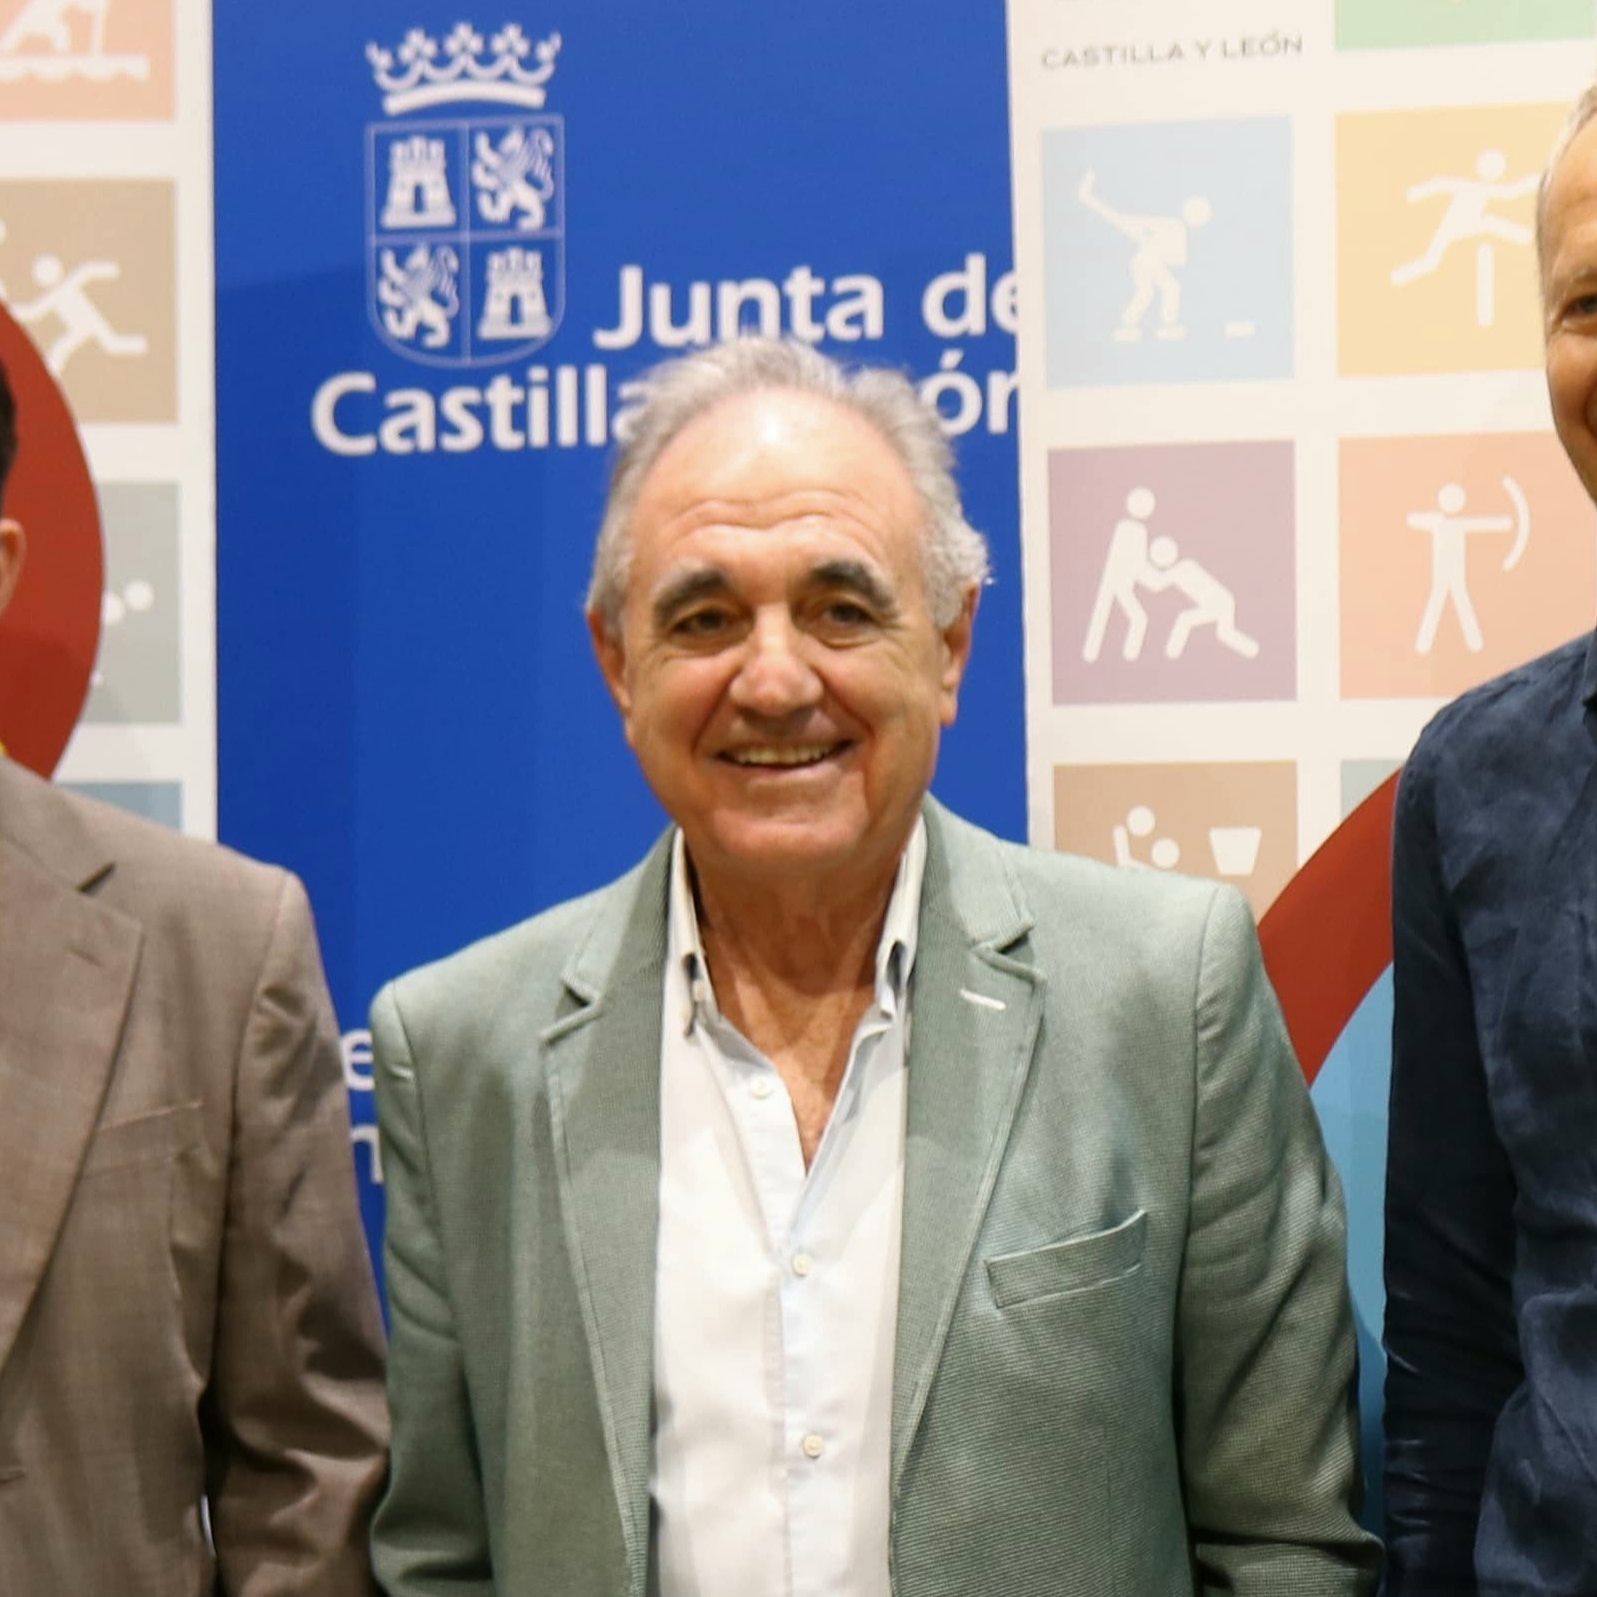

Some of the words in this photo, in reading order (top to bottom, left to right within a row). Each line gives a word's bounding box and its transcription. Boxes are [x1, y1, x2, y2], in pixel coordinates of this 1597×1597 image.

[1042, 42, 1184, 69] CASTILLA
[1194, 37, 1213, 61] Y
[1222, 29, 1303, 59] LEÓN
[592, 264, 885, 351] Junta
